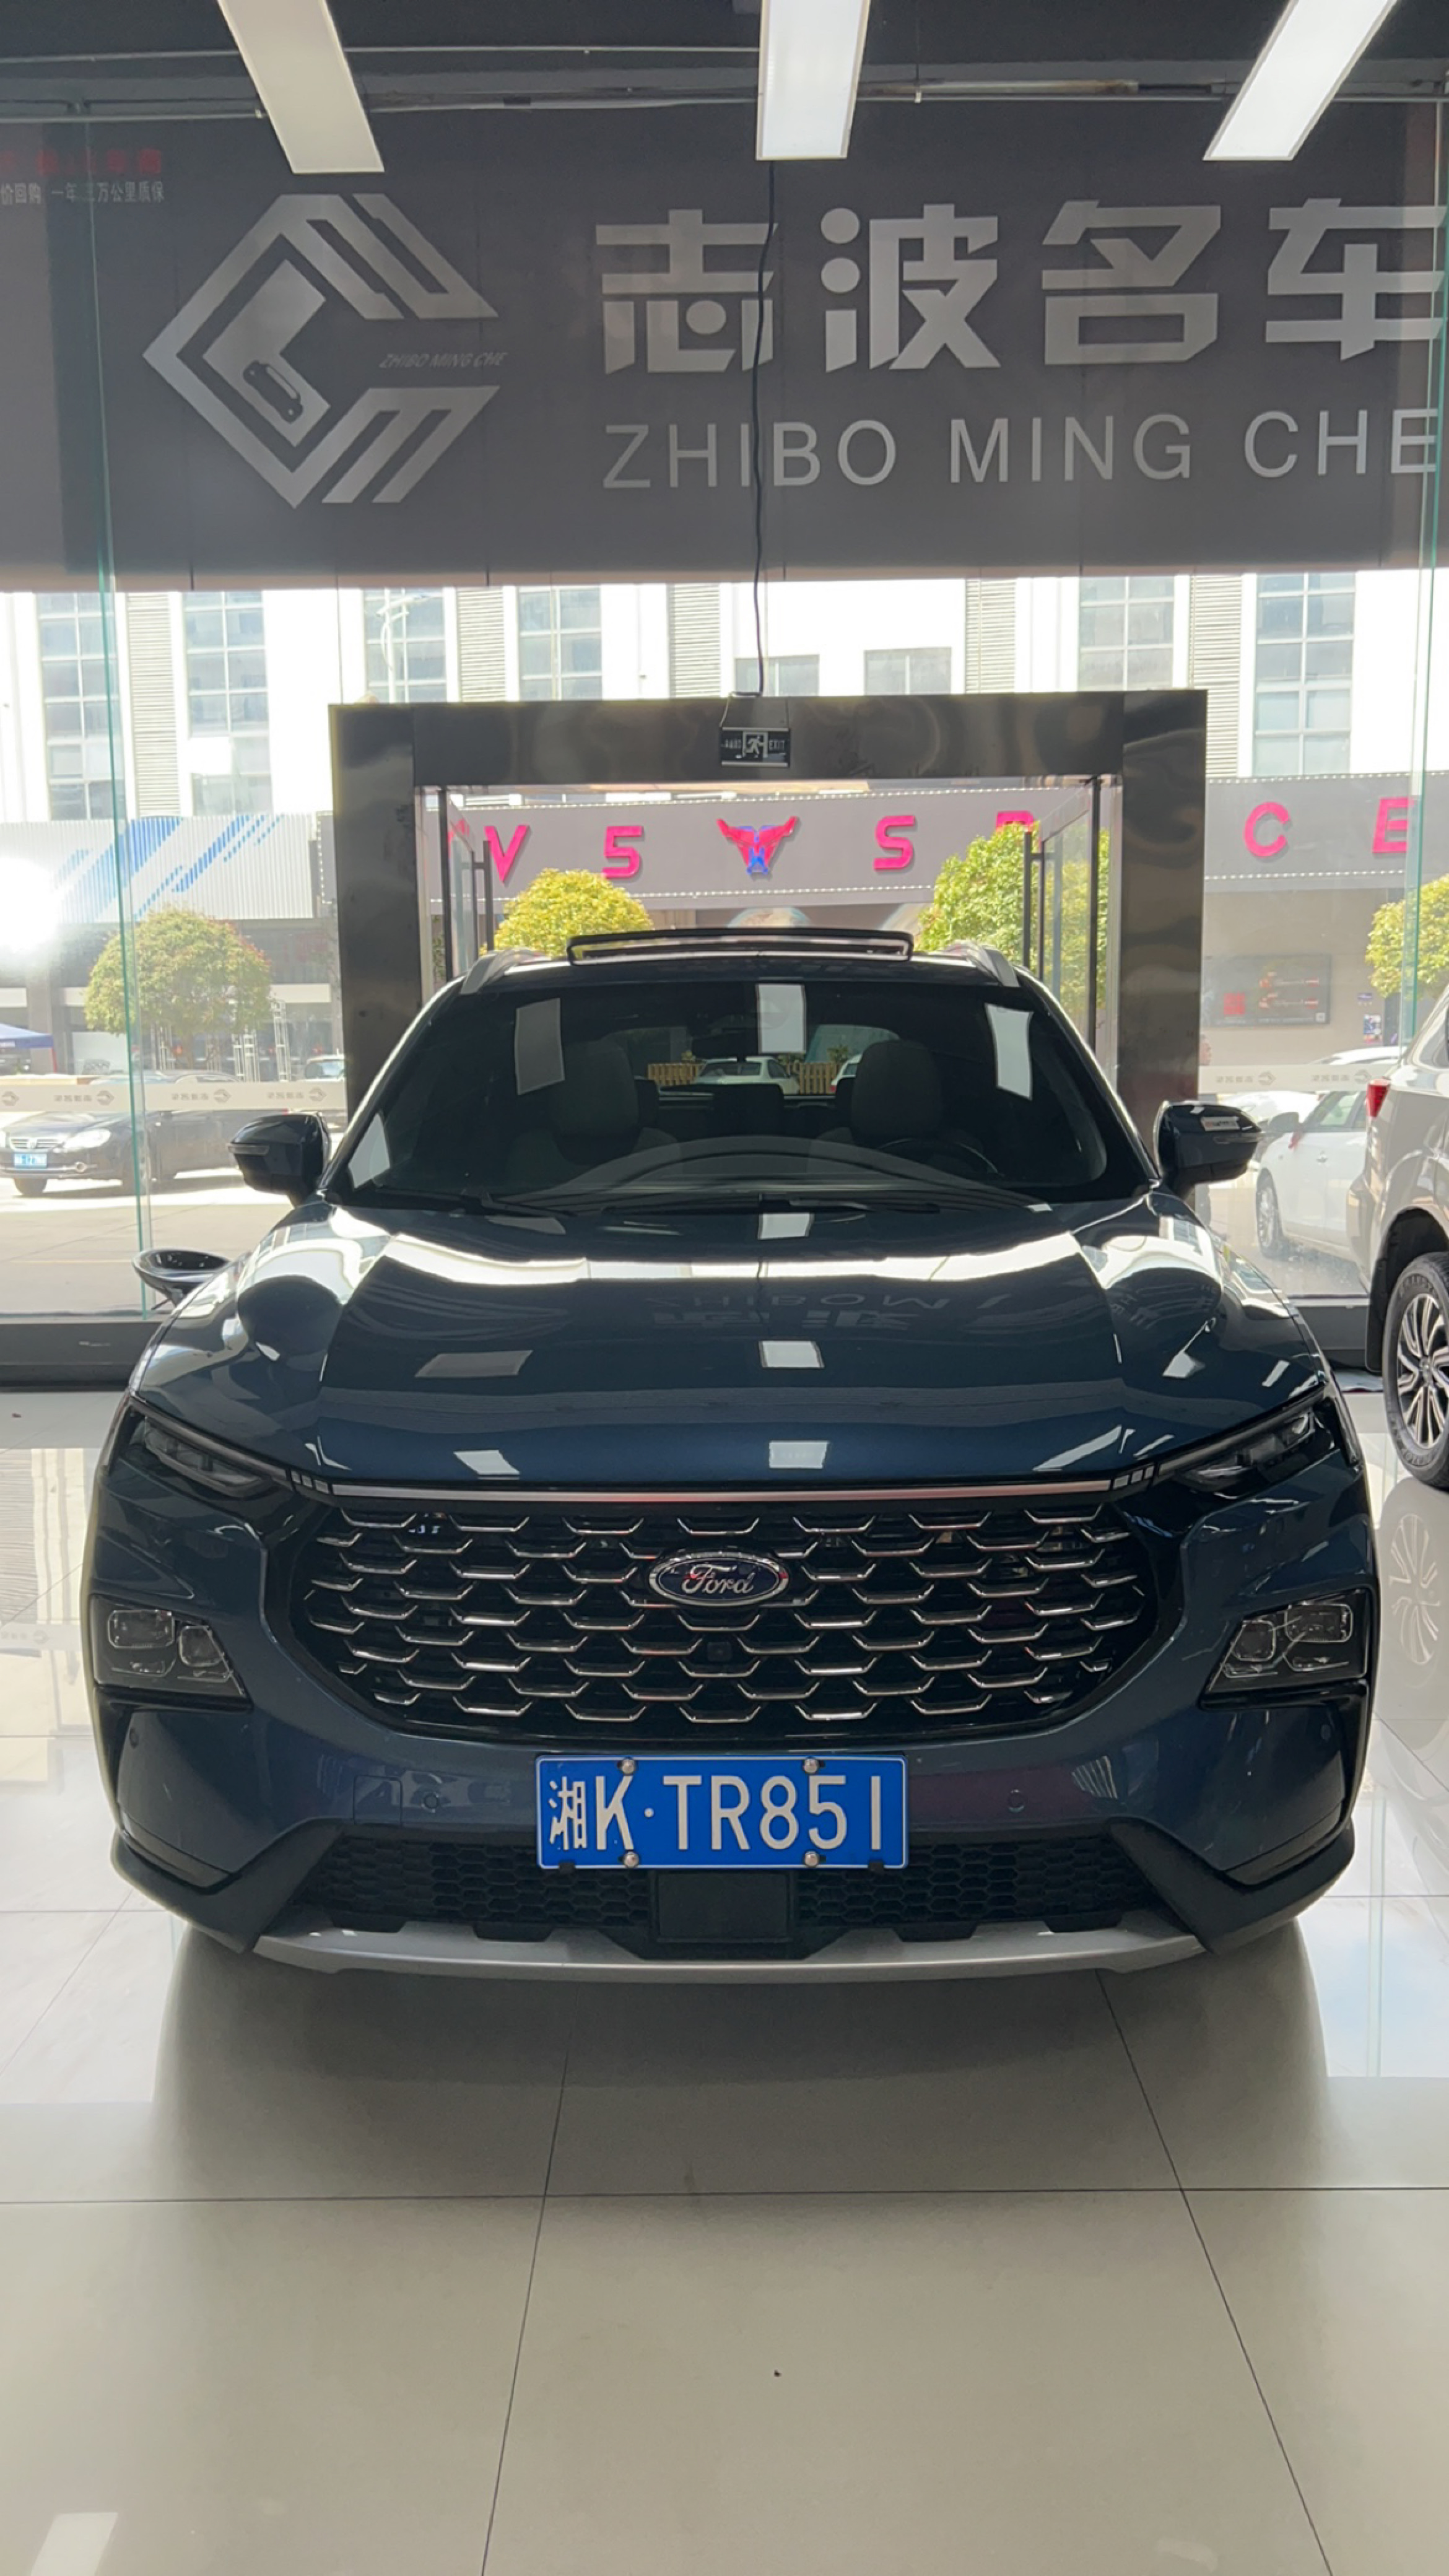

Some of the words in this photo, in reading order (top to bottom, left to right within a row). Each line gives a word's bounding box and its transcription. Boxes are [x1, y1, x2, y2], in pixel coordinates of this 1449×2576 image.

[596, 198, 1448, 374] 志波名车
[603, 419, 897, 488] ZHIBO
[950, 413, 1191, 483] MING
[1243, 408, 1438, 477] CHE
[682, 1563, 757, 1594] Ford
[549, 1775, 881, 1852] 湘K·TR851
